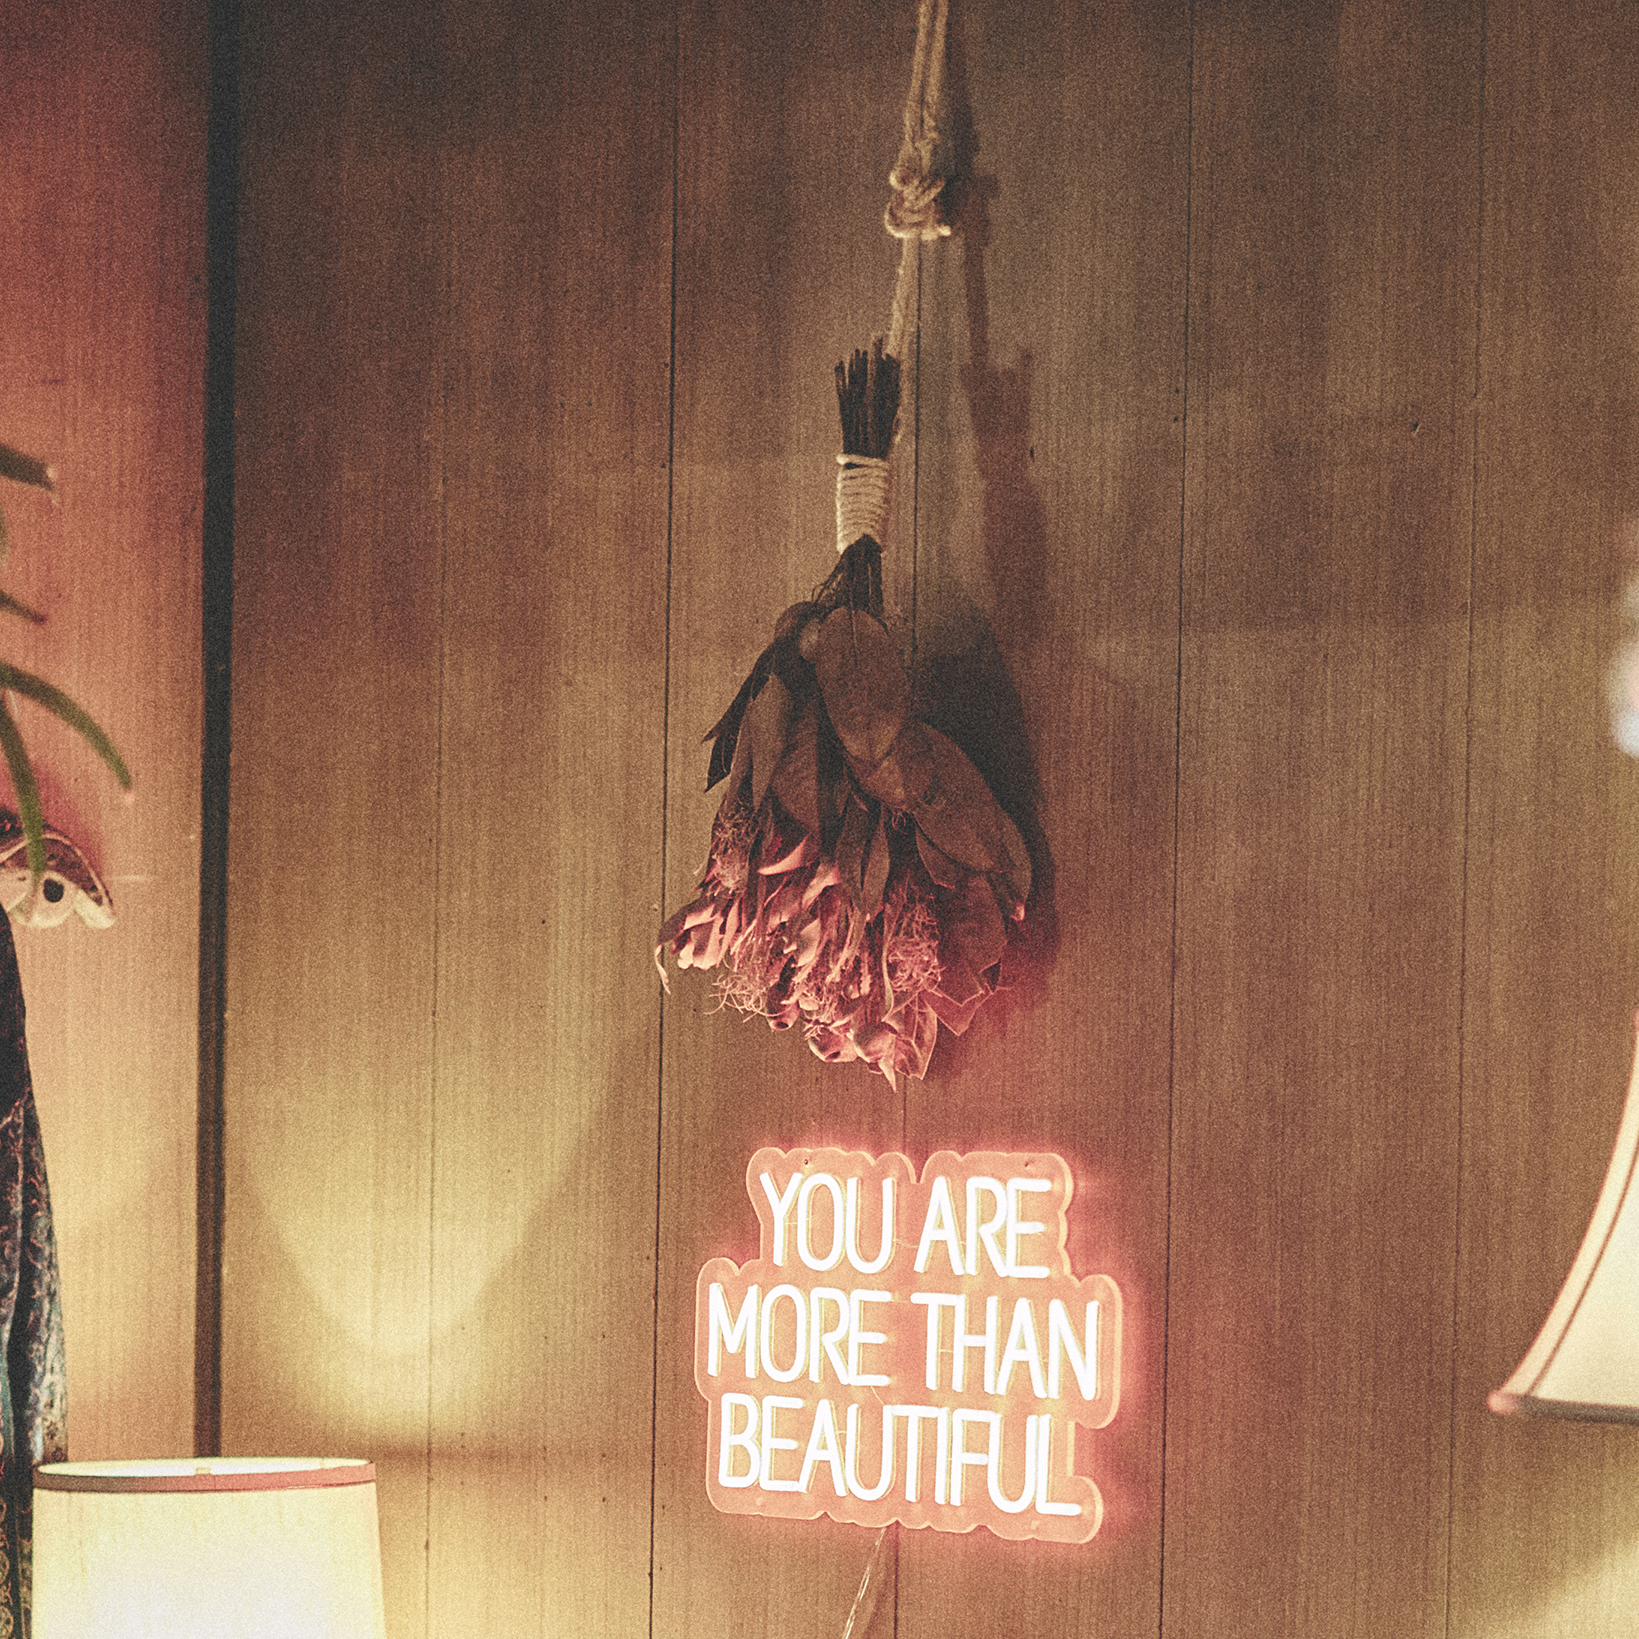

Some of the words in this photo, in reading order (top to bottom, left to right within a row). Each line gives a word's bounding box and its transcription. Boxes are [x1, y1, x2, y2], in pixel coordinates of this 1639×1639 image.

[760, 1172, 894, 1274] YOU
[914, 1176, 1052, 1278] ARE
[708, 1282, 892, 1387] MORE
[911, 1292, 1100, 1400] THAN
[718, 1393, 1082, 1516] BEAUTIFUL
